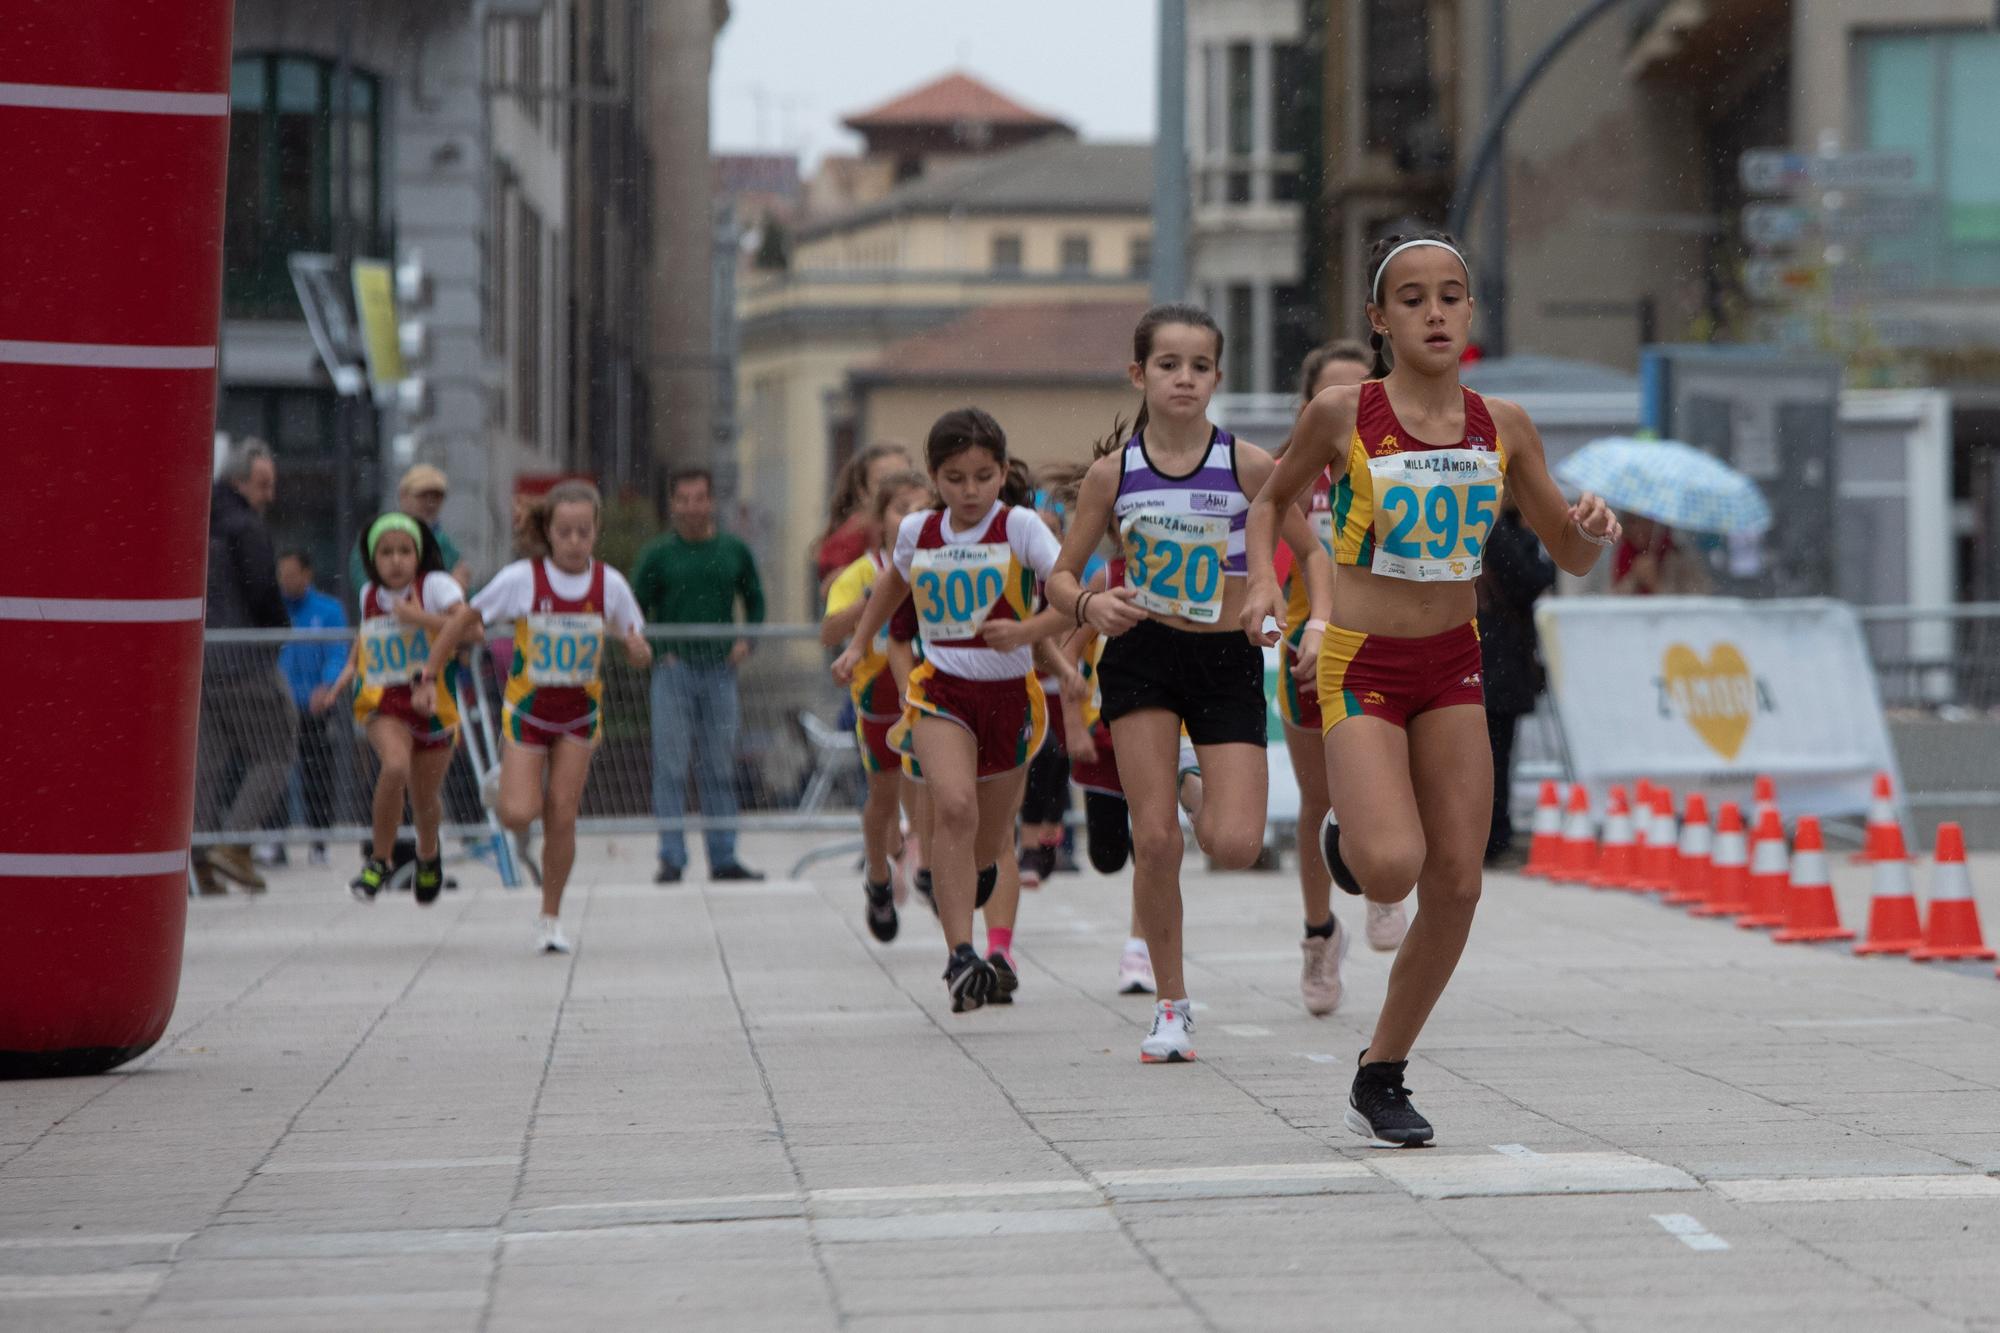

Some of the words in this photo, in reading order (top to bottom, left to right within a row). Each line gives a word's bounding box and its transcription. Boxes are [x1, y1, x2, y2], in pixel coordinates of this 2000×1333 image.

[1382, 485, 1497, 559] 295
[916, 566, 1003, 623] 300
[1128, 530, 1219, 603] 320
[366, 627, 430, 674] 304
[532, 633, 599, 672] 302
